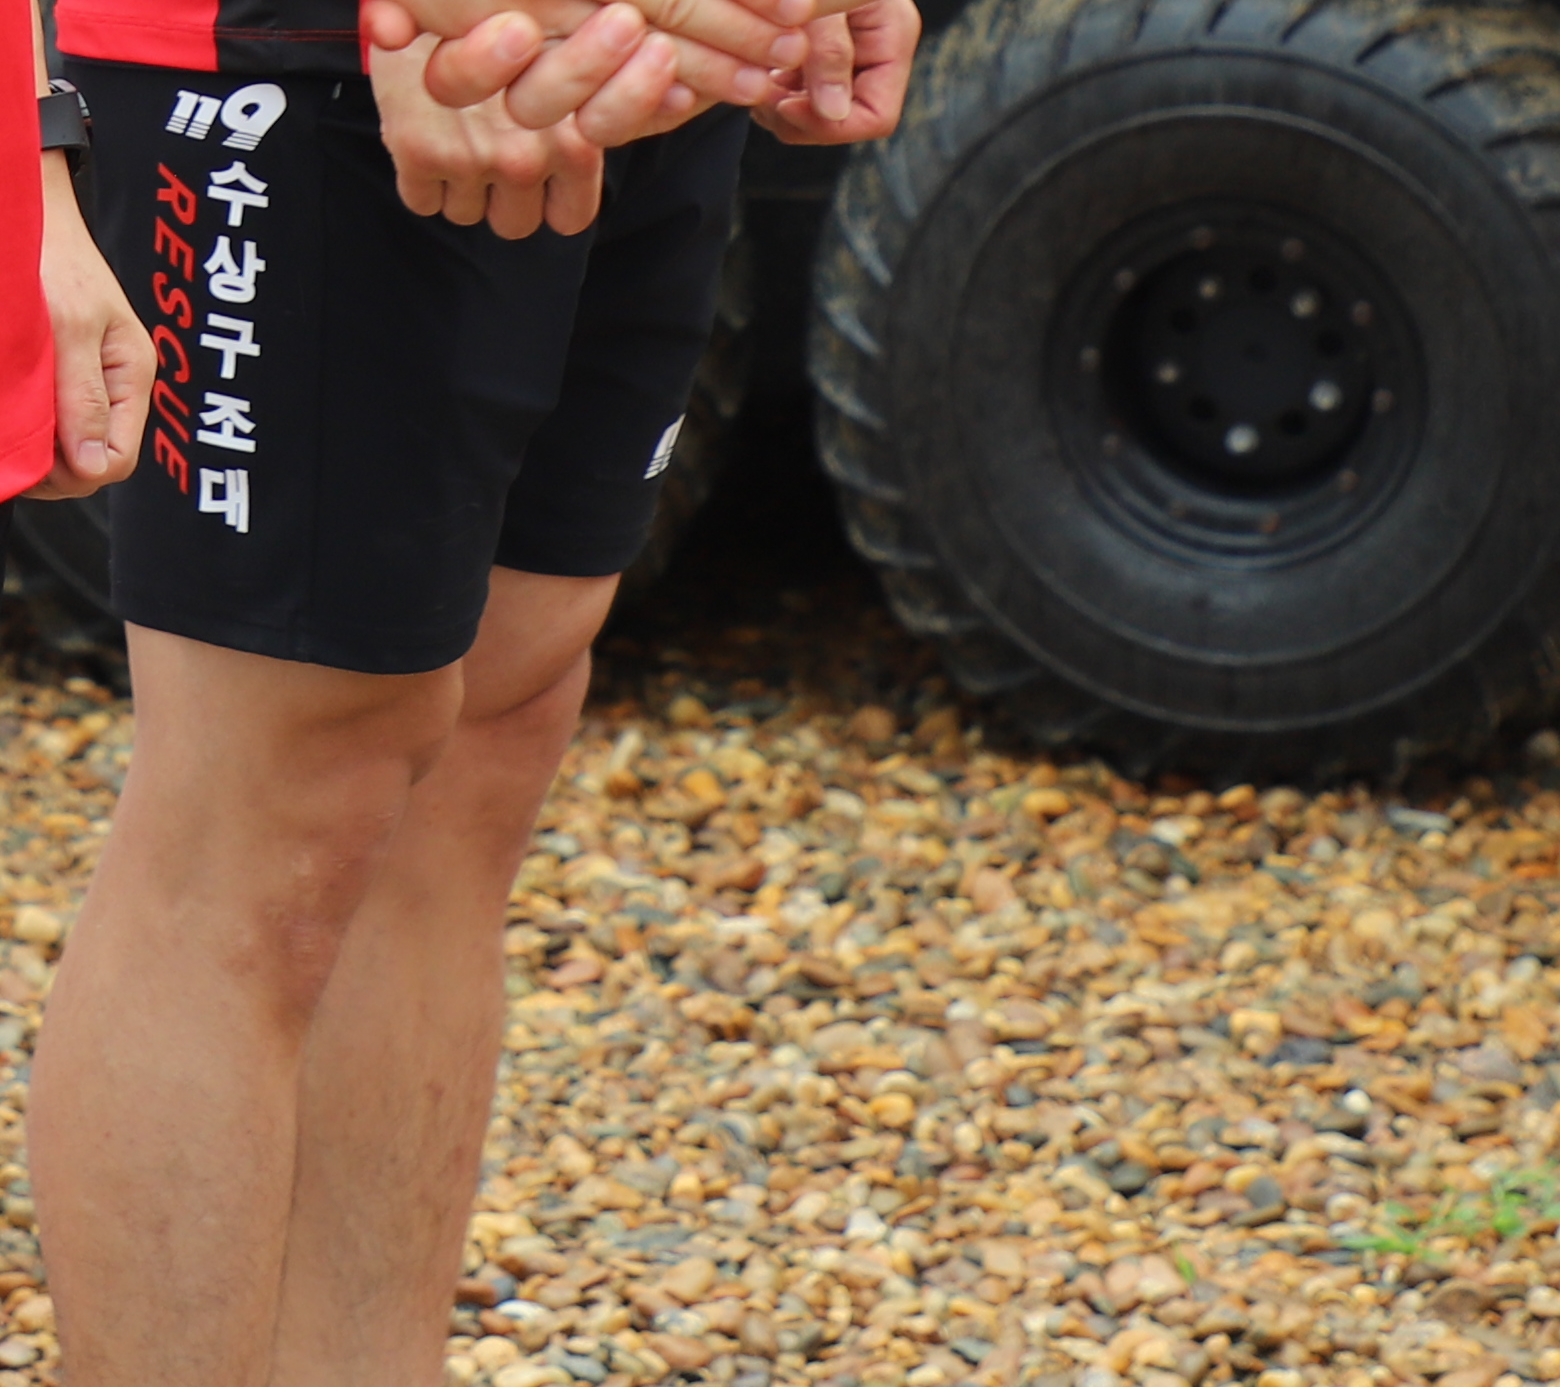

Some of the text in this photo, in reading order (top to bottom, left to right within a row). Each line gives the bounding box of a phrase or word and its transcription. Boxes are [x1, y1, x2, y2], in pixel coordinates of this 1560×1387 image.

[165, 82, 287, 152] 119
[153, 162, 197, 495] RESCUE
[196, 159, 269, 534] 수상구조대
